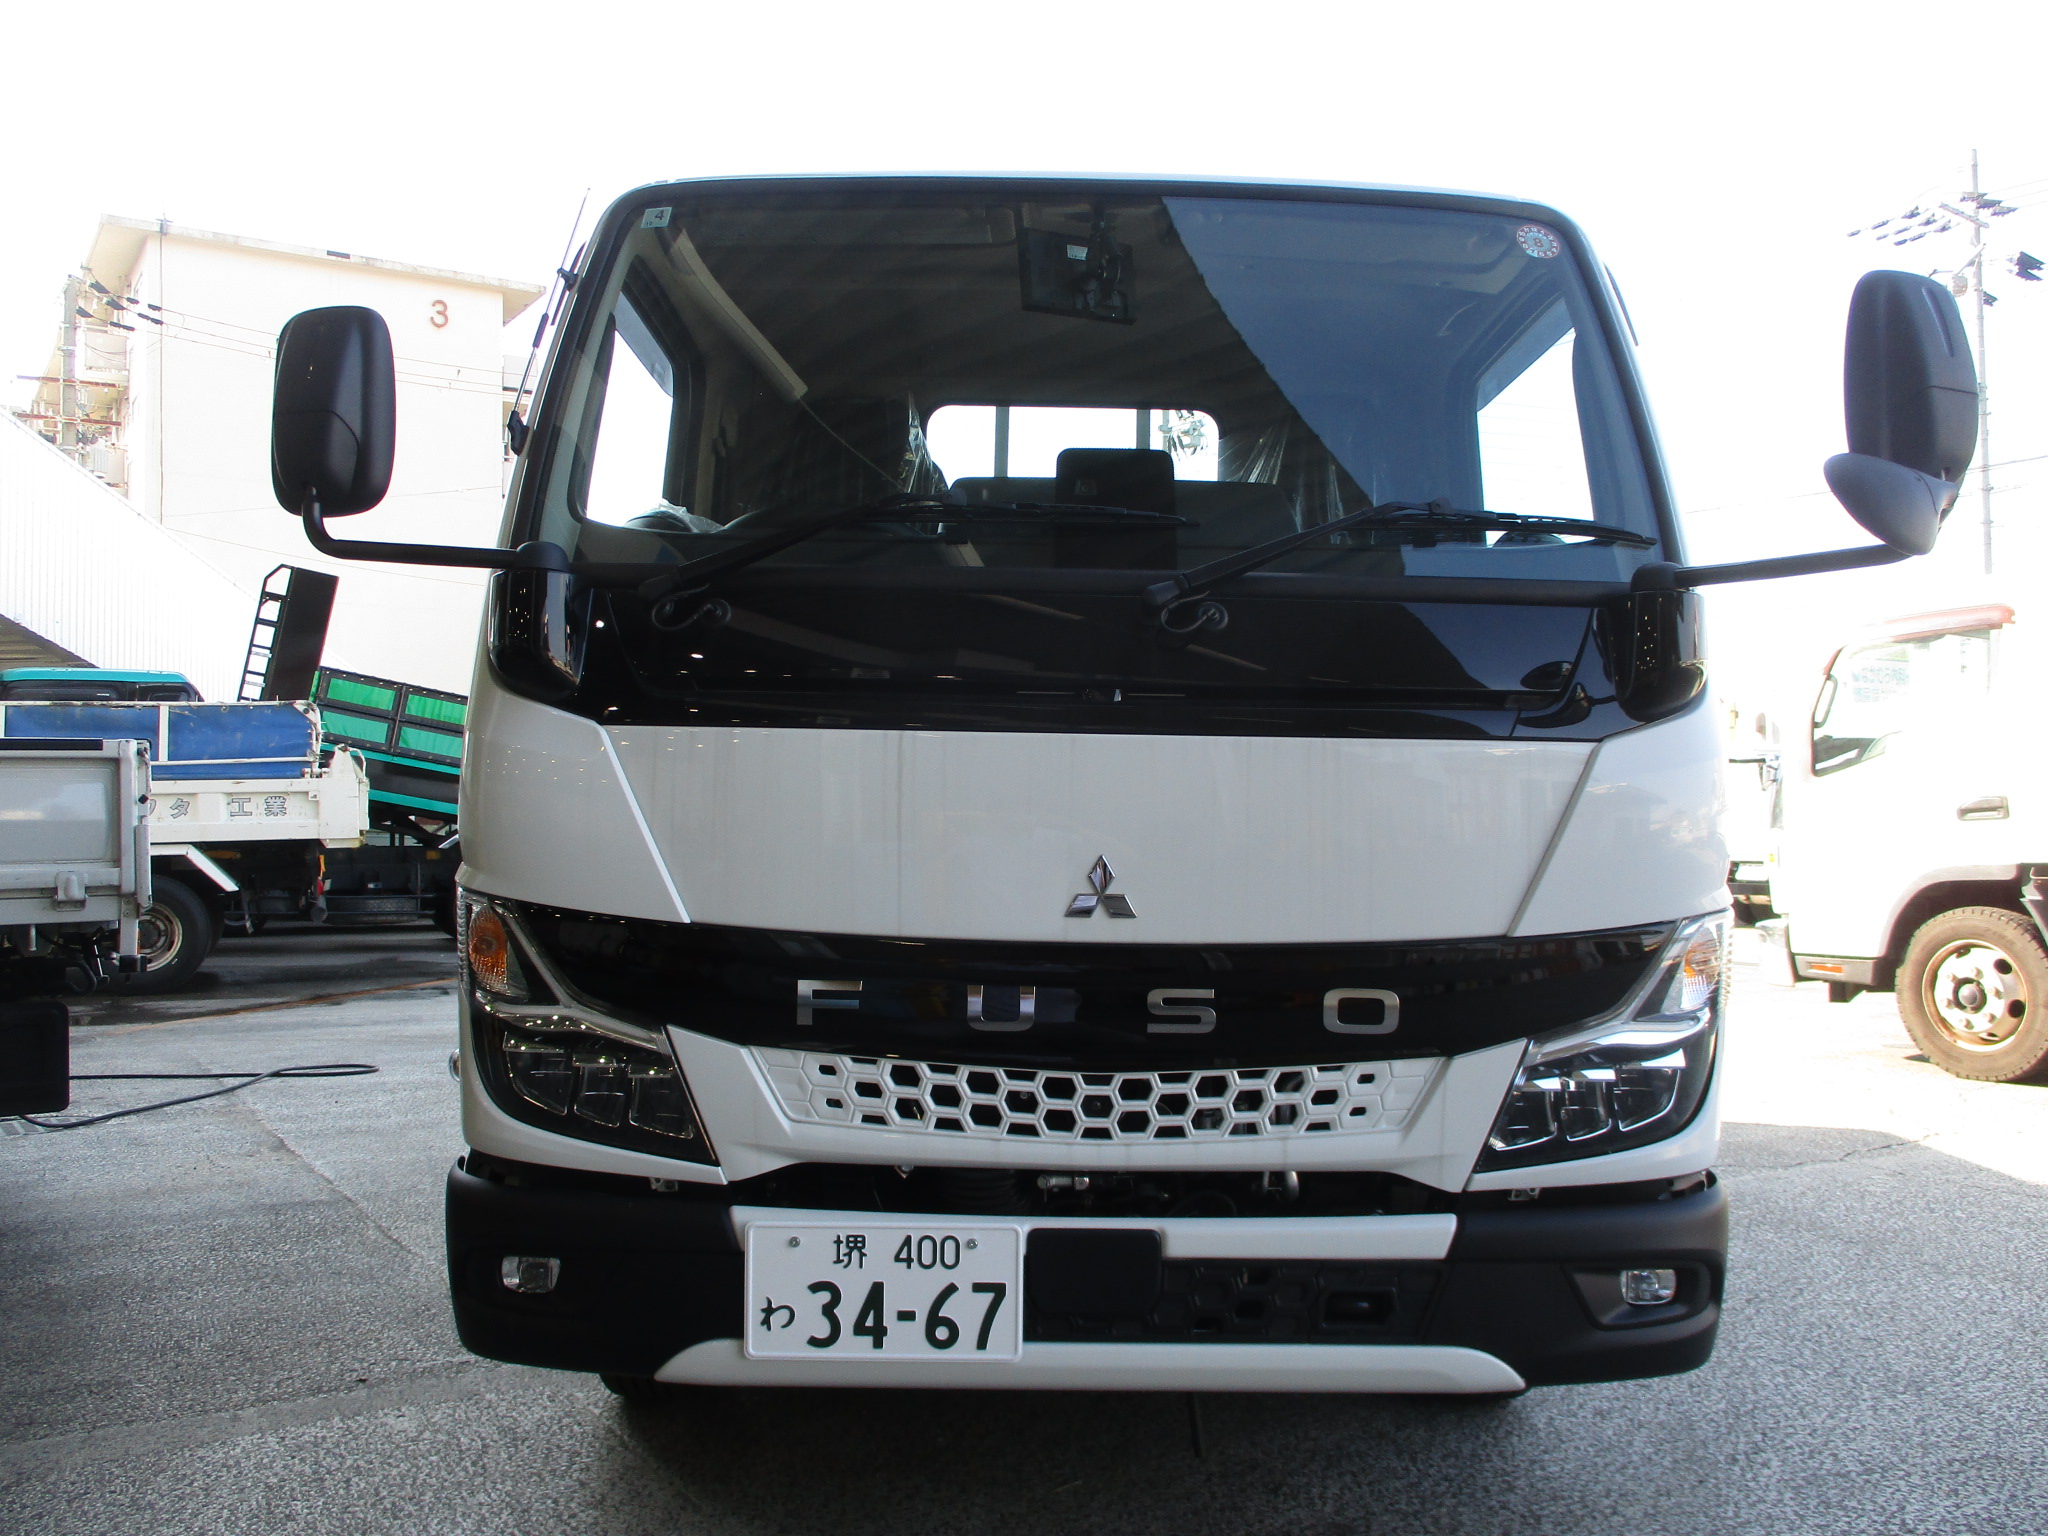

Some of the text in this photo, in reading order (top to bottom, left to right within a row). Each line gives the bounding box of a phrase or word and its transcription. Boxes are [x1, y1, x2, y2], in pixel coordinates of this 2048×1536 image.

[654, 209, 665, 221] 4
[430, 299, 449, 328] 3
[796, 979, 1400, 1035] FUSO
[833, 1234, 961, 1270] 堺 400
[760, 1280, 1007, 1351] わ 34-67
